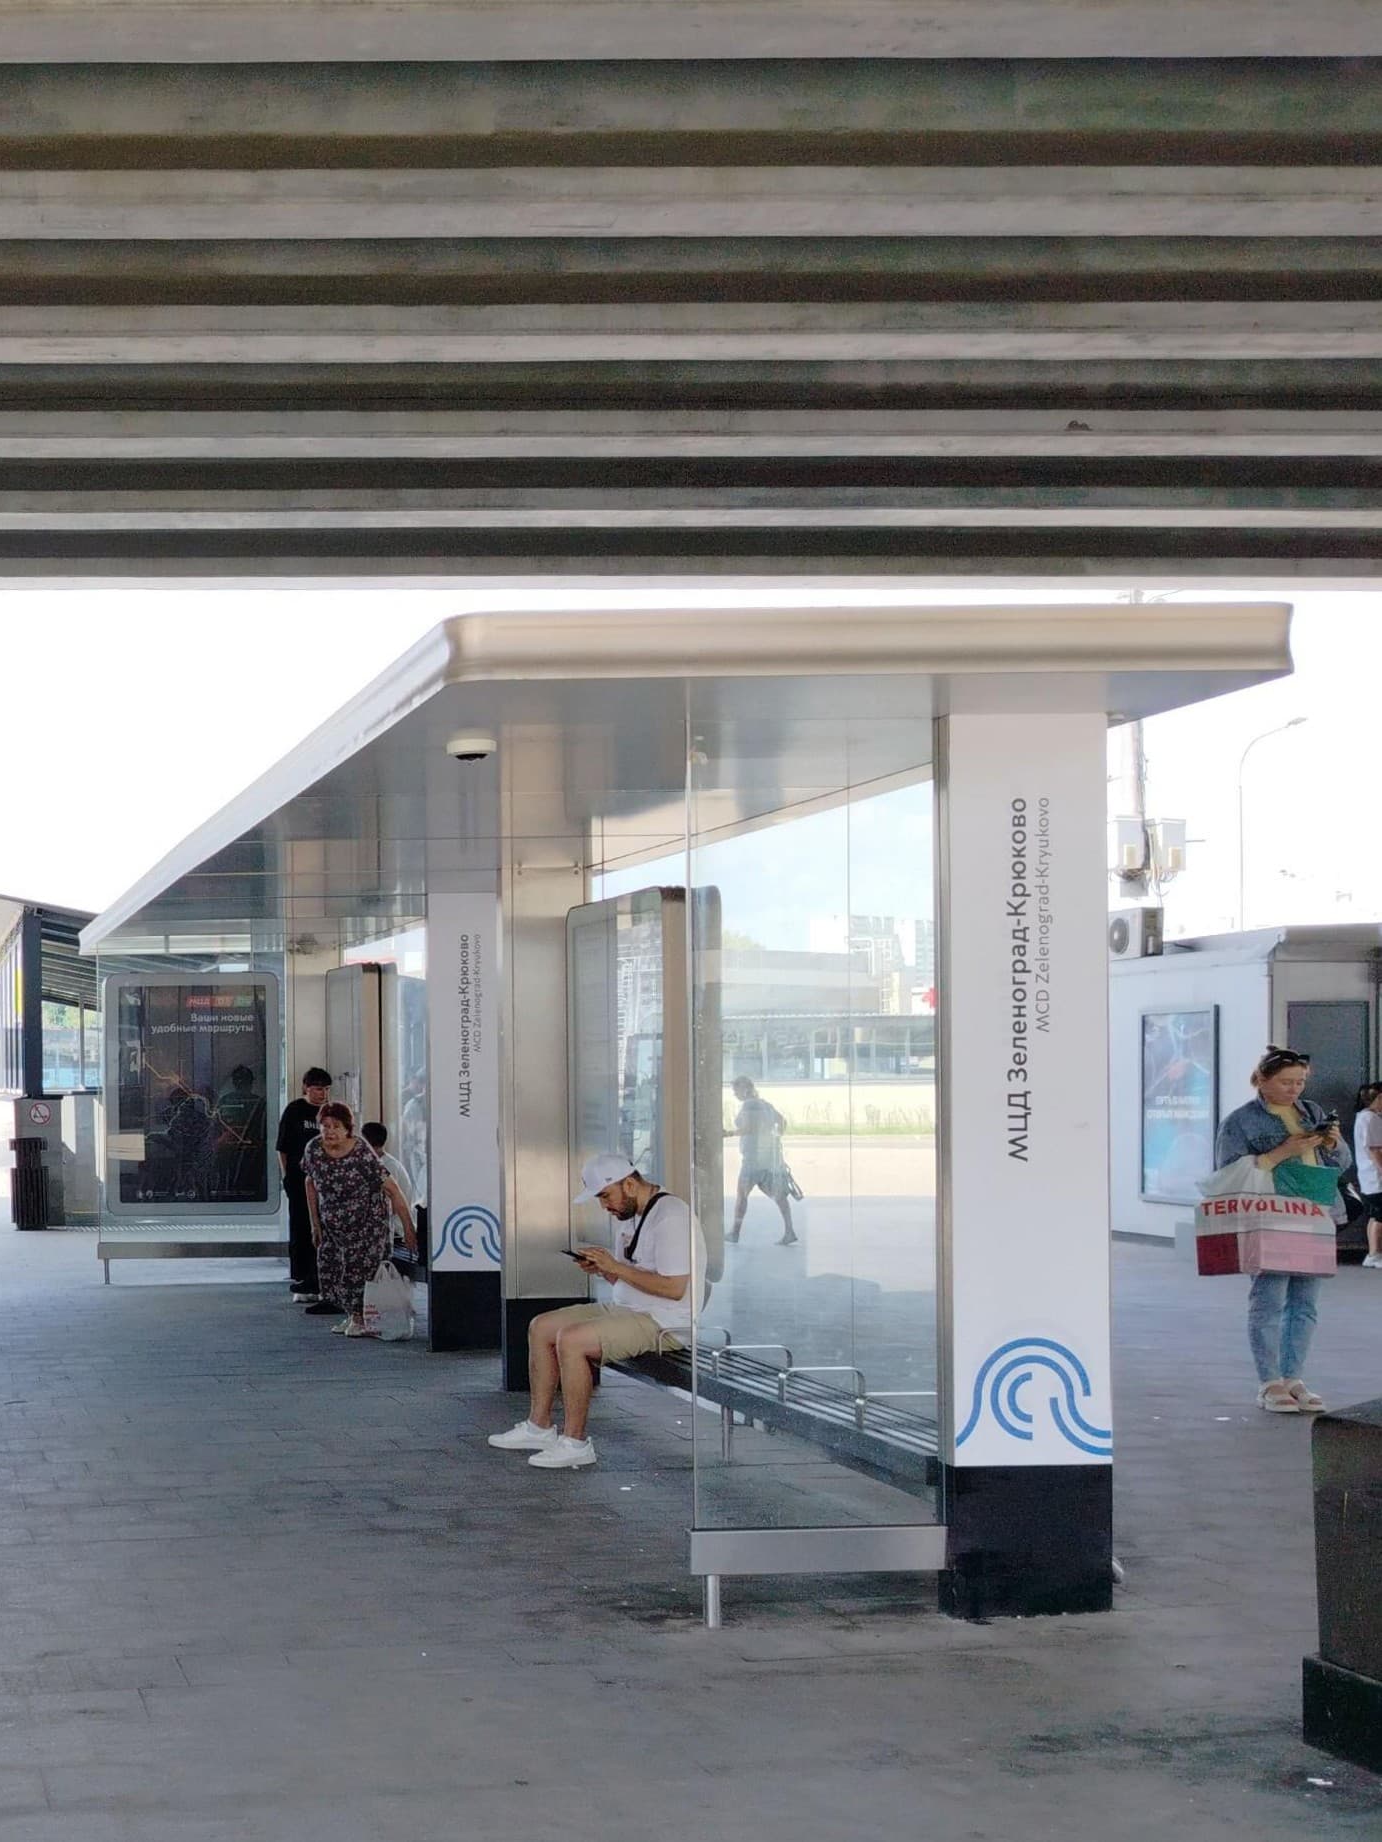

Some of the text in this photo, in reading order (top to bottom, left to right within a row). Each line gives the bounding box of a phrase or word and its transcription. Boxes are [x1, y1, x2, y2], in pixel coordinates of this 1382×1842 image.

[1034, 797, 1053, 1033] MCD Zelenograd-Kryukovo
[151, 1023, 254, 1035] удобные маршруты
[190, 1012, 255, 1023] Ваши новые
[458, 933, 472, 1118] МЦД Зеленоград-Крюково
[1006, 797, 1032, 1163] МЦД Зеленоград-Крюково
[1201, 1199, 1325, 1217] TERVOLINA
